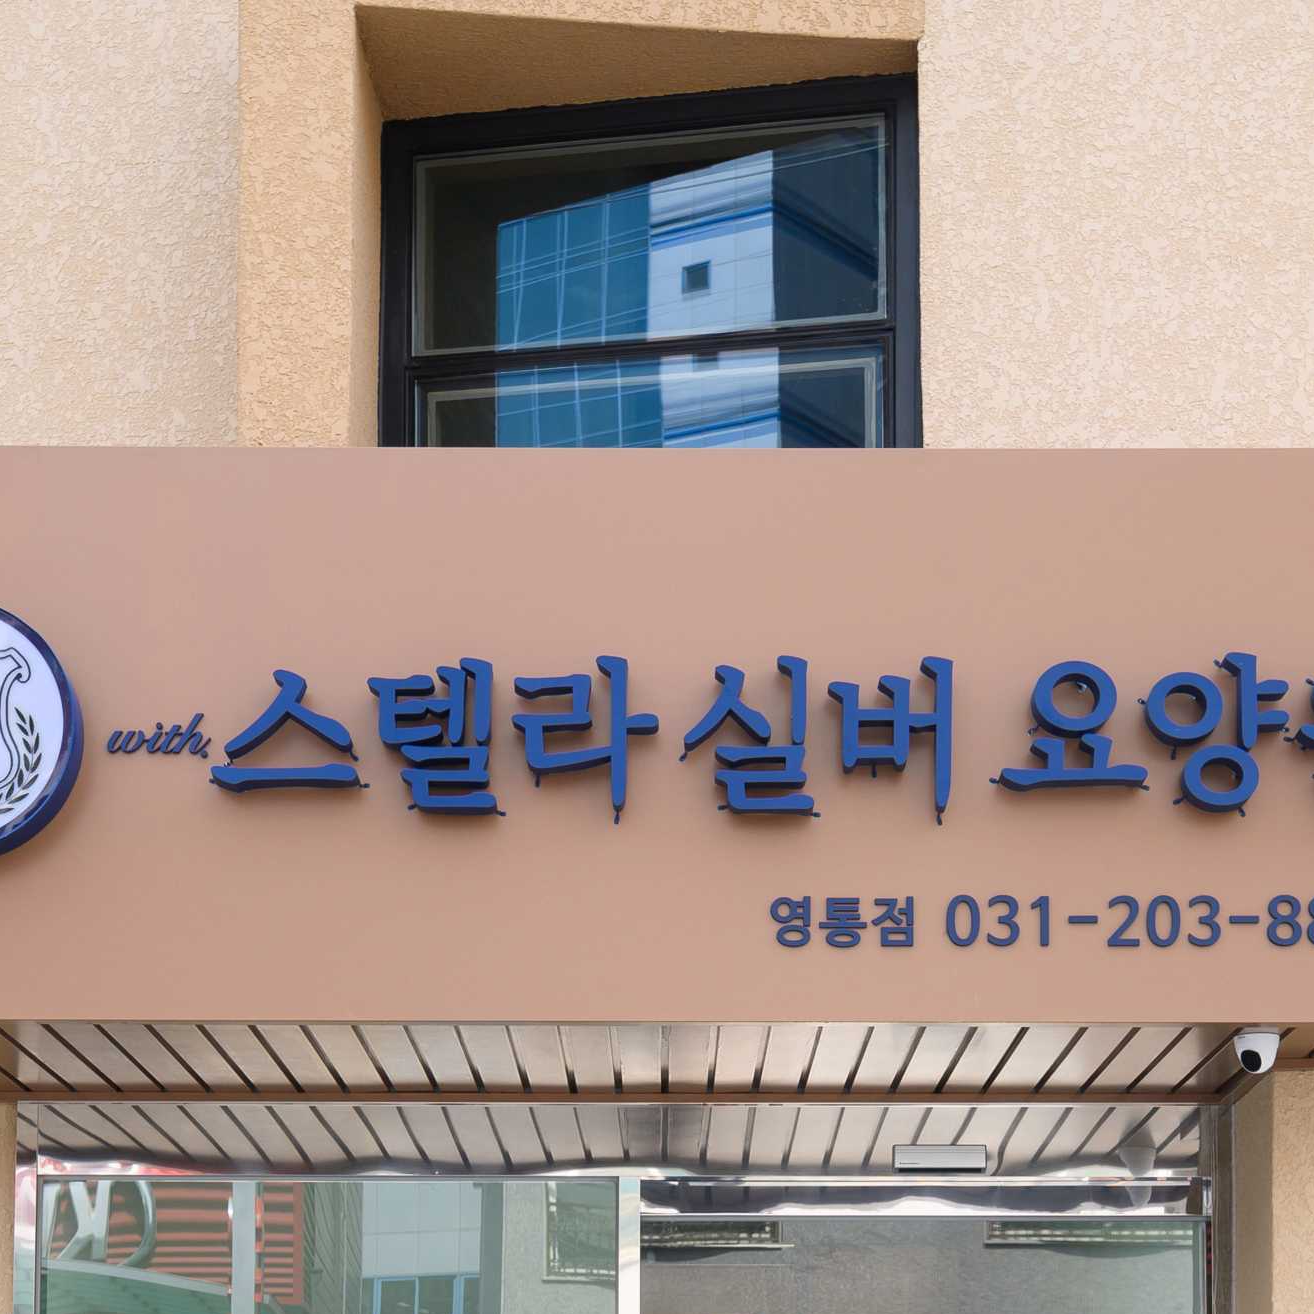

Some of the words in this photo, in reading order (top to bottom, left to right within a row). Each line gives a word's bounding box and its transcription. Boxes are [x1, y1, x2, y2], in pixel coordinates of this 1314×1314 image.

[209, 656, 659, 822] 스텔라
[681, 656, 954, 822] 실버
[769, 896, 915, 948] 영통점
